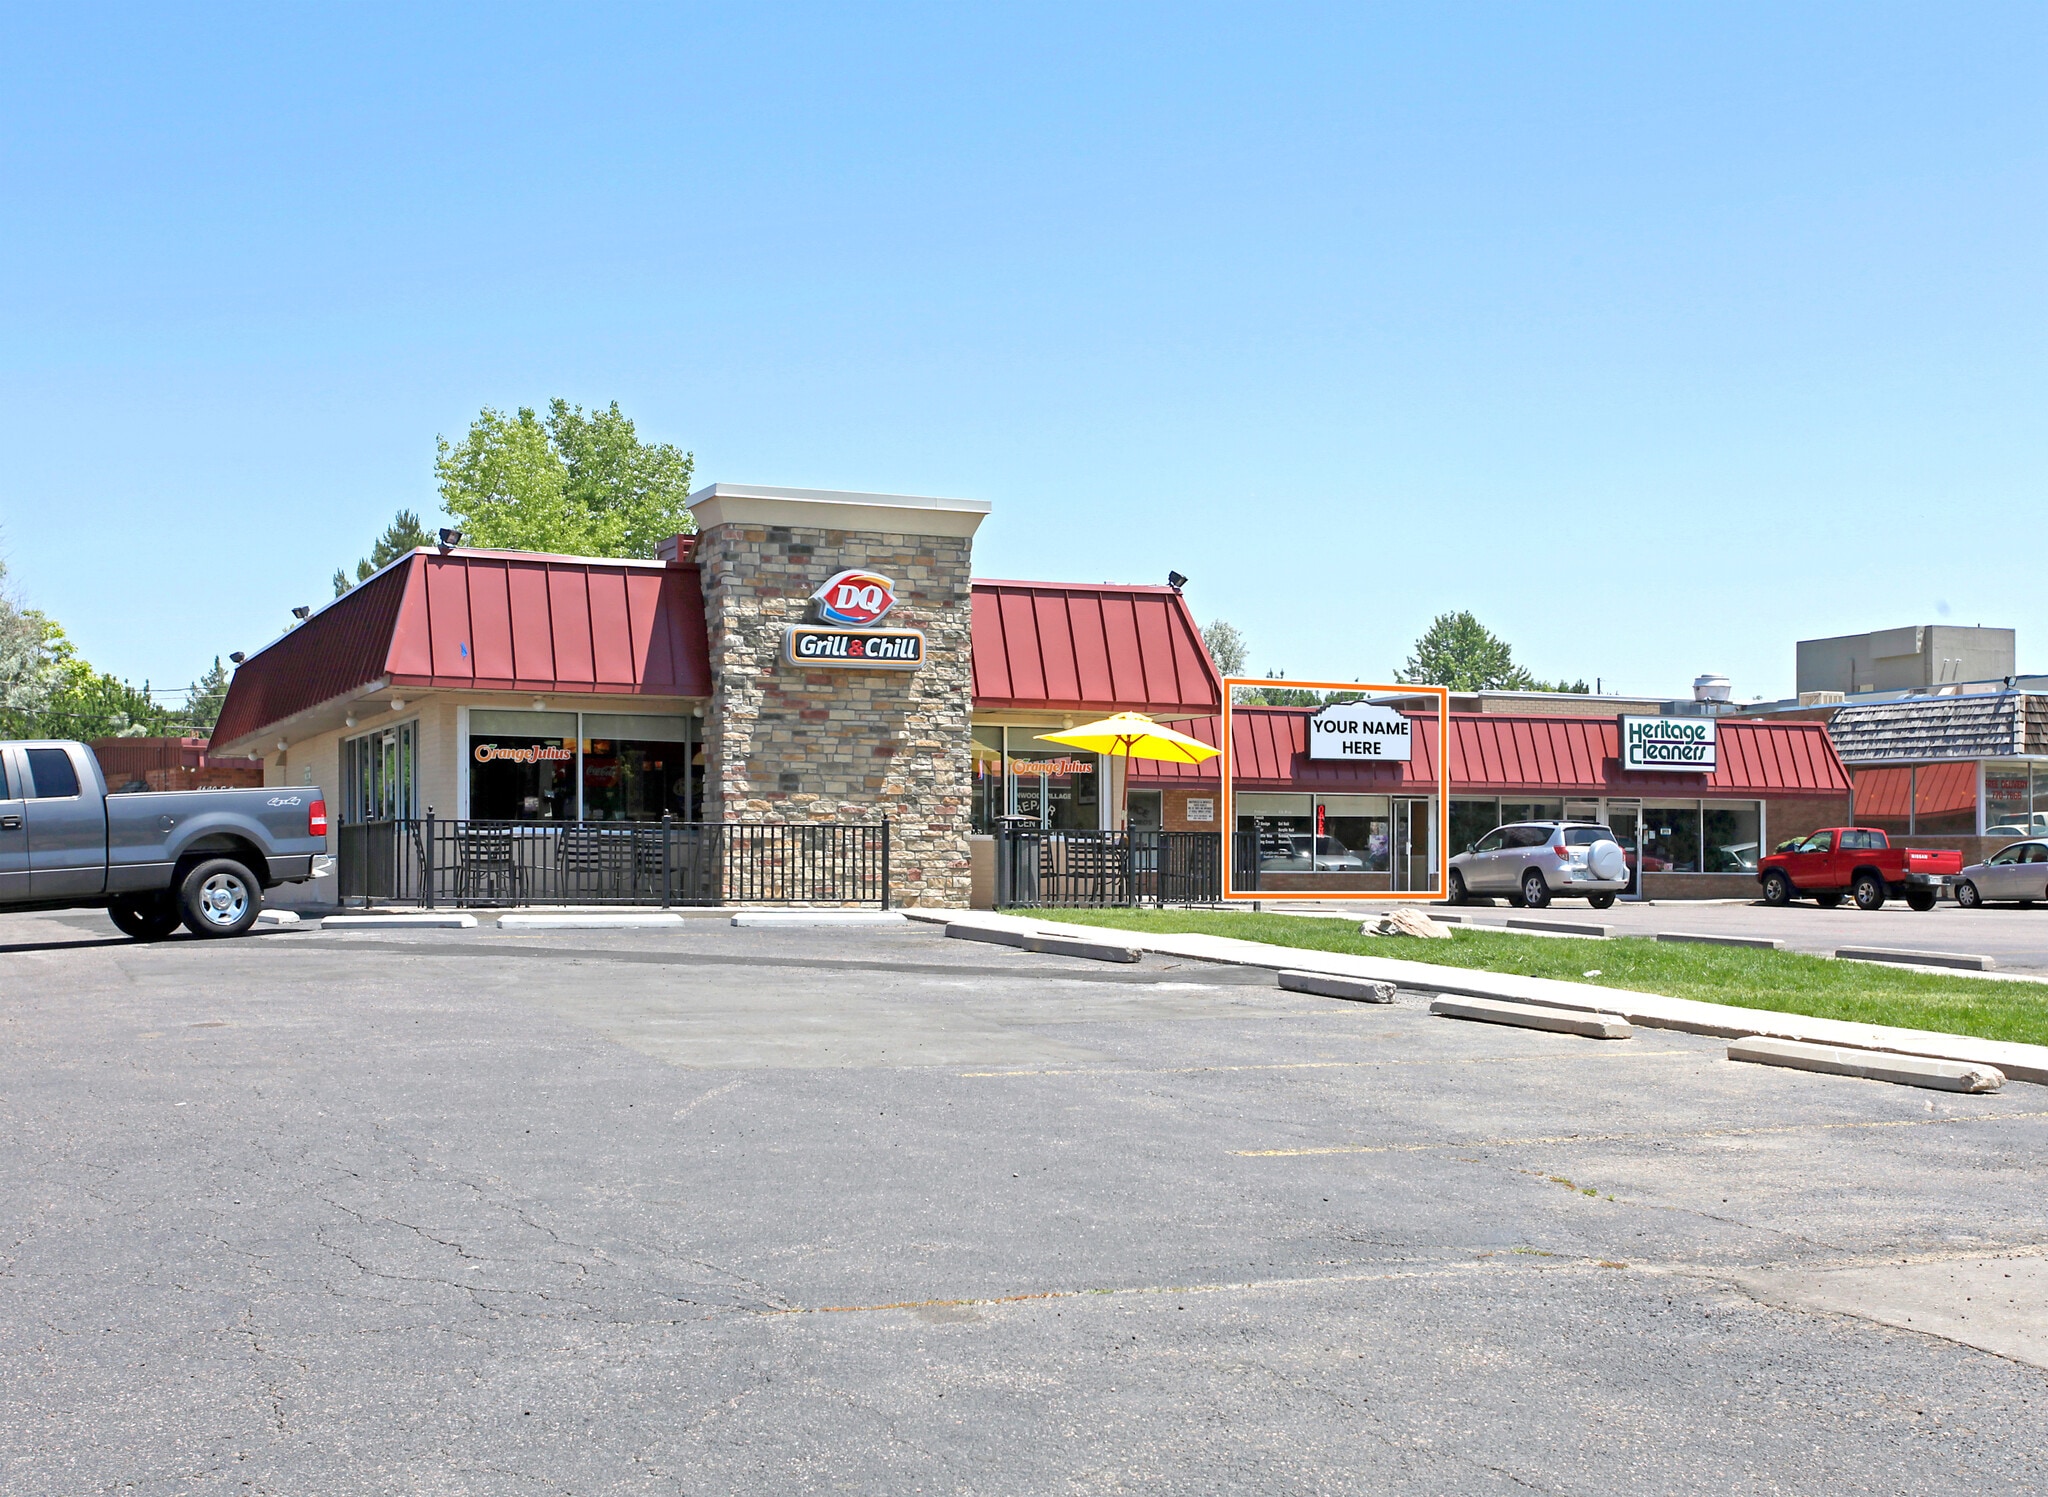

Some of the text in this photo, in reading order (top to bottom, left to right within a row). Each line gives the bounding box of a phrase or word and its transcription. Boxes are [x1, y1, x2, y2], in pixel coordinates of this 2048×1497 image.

[835, 584, 883, 613] DQ
[1313, 719, 1409, 735] YOUR NAME
[1629, 720, 1706, 745] Heritage
[1342, 741, 1381, 755] HERE
[1629, 739, 1706, 765] Cleaners
